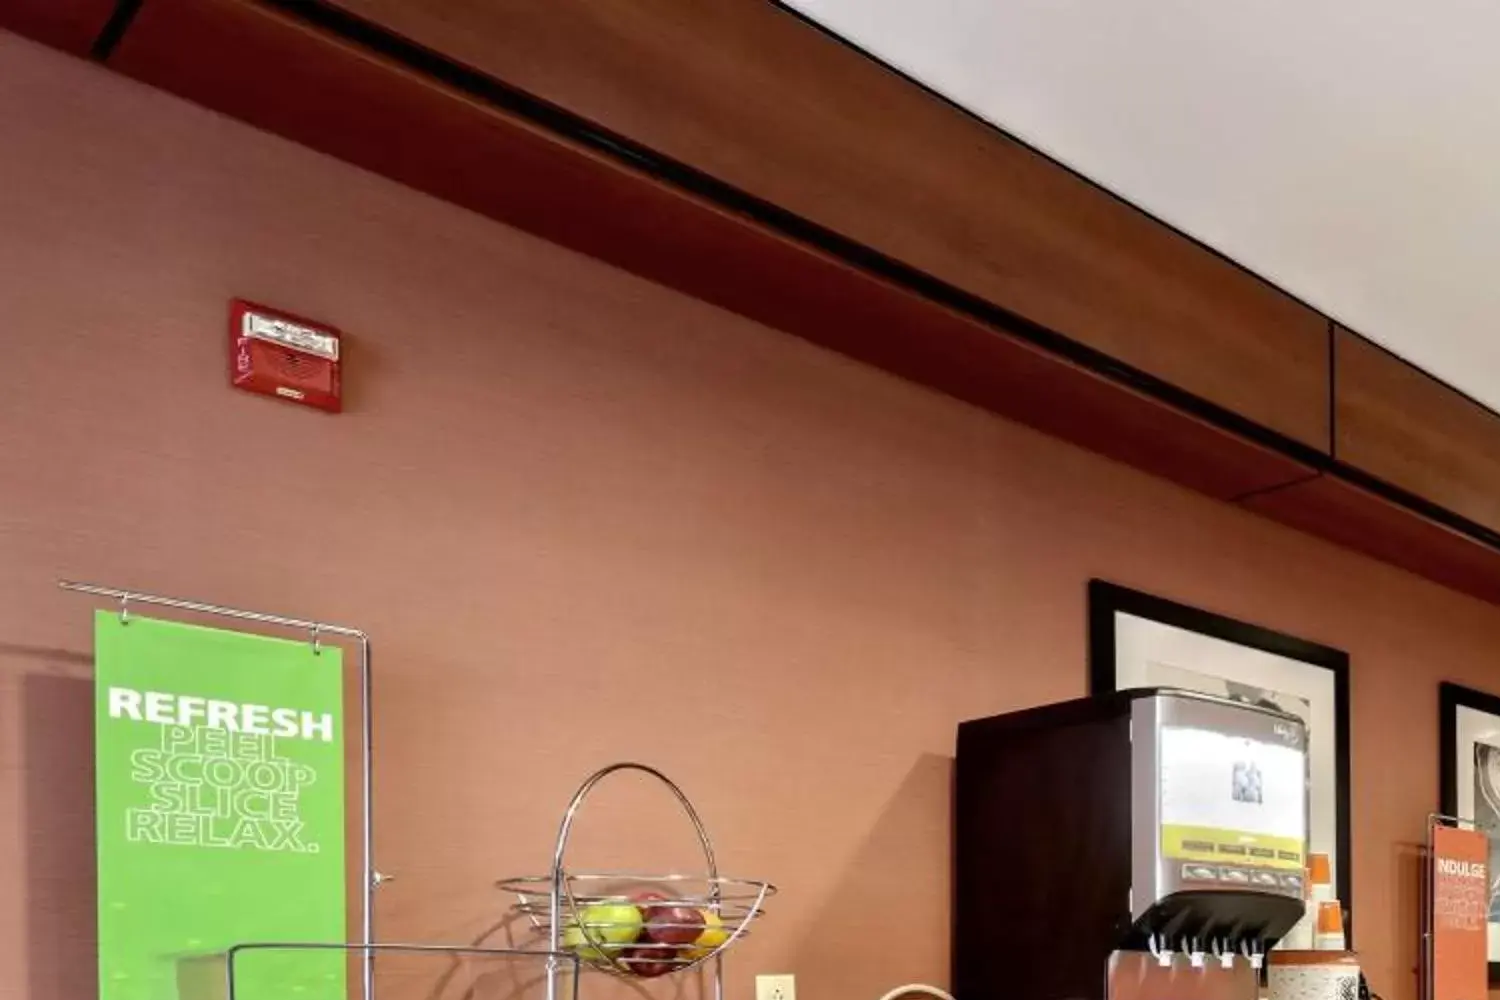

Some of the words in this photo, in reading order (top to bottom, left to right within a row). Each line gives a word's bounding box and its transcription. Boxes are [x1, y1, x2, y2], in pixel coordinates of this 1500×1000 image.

[107, 686, 334, 743] REFRESH
[160, 721, 289, 763] PEEL
[130, 748, 317, 795] SCOOP
[150, 780, 300, 824] SLICE
[126, 807, 320, 854] RELAX.
[1437, 857, 1487, 879] INDULGE
